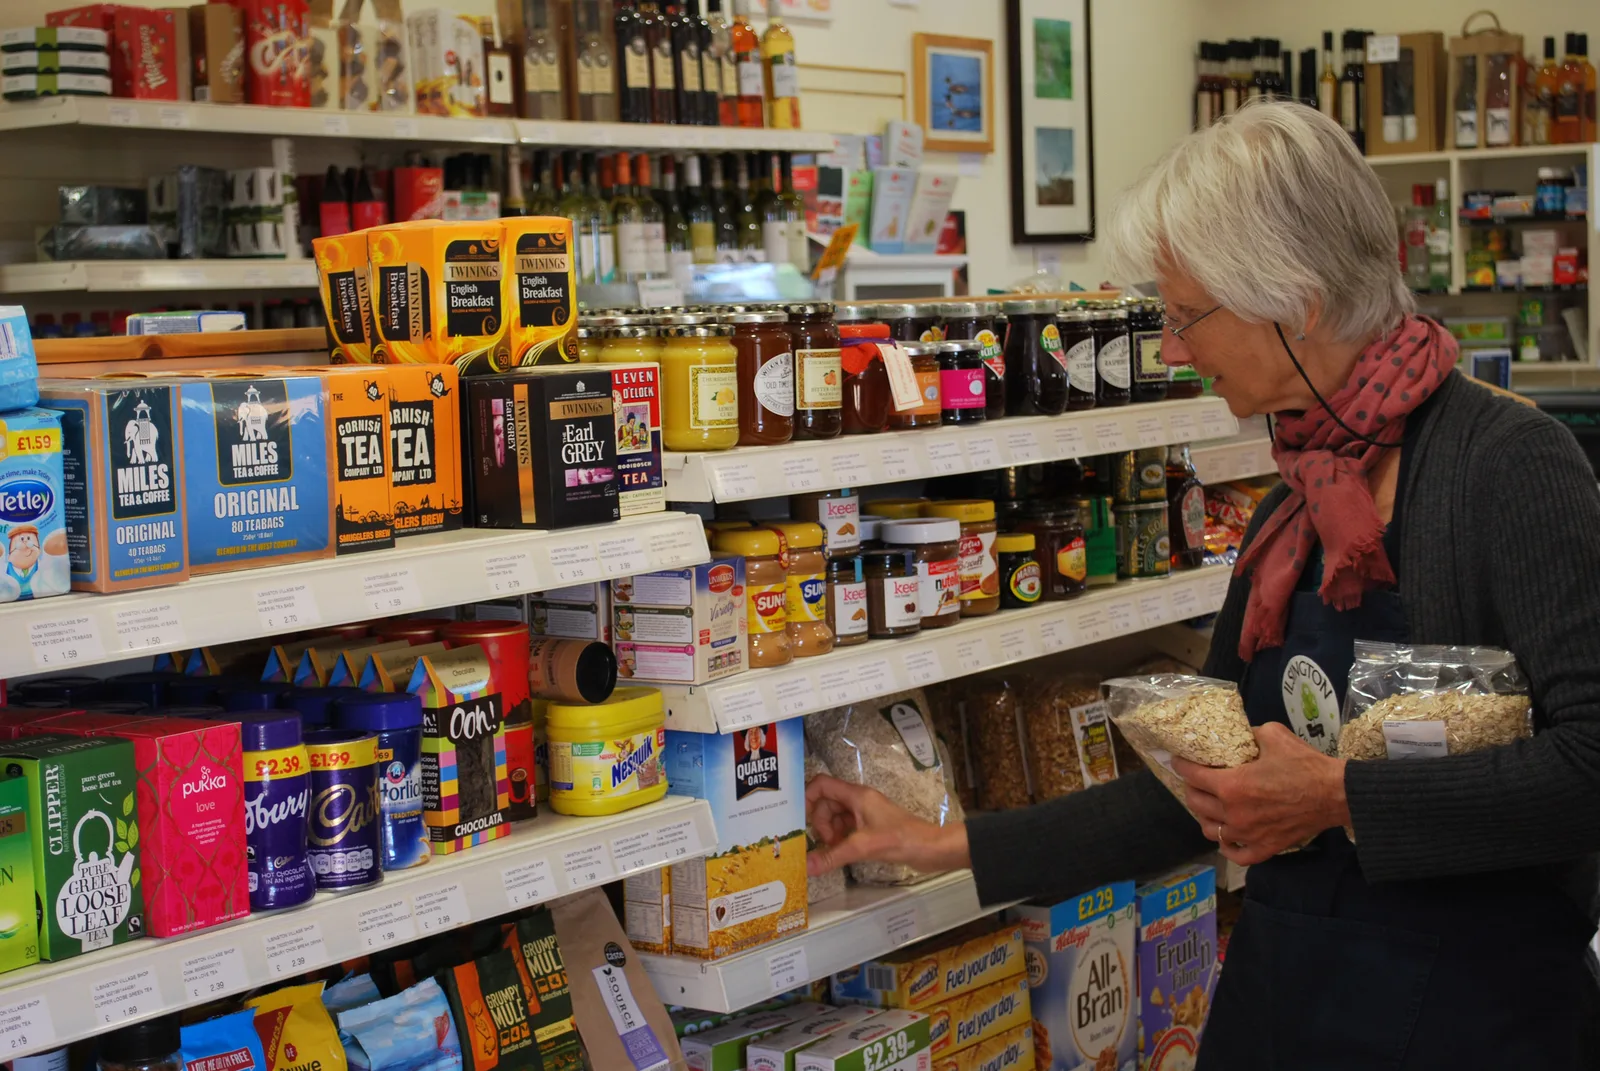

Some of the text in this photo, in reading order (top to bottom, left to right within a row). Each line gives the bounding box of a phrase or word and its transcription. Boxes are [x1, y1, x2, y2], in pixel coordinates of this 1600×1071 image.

[449, 264, 498, 279] TWININGS
[520, 258, 566, 270] TWININGS
[522, 276, 548, 287] English
[347, 277, 357, 311] English
[398, 272, 407, 308] English
[450, 284, 478, 297] English
[522, 286, 563, 299] Breakfast
[338, 278, 354, 334] Breakfast
[390, 272, 400, 331] Breakfast
[410, 272, 421, 337] TWININGS
[451, 296, 494, 308] Breakfast
[568, 344, 577, 355] 50
[500, 356, 508, 365] 50
[432, 378, 443, 393] 80
[615, 371, 655, 385] LEVEN
[332, 393, 343, 402] THE
[368, 386, 378, 396] 40
[623, 386, 655, 400] O'CLOCK
[561, 402, 604, 416] TWININGS
[338, 420, 381, 436] CORNISH
[506, 400, 516, 452] Earl GREY
[516, 398, 530, 465] TWININGS
[565, 422, 594, 444] Earl
[17, 435, 52, 451] £1.59
[342, 435, 382, 467] TEA
[232, 441, 279, 467] MILES
[561, 441, 604, 465] GREY
[233, 464, 279, 479] TEA & COFFEE
[344, 466, 383, 478] COMPANY LTD
[618, 461, 652, 470] ROOIBOSCH
[118, 464, 170, 493] MILES
[420, 468, 432, 480] LTD
[622, 472, 648, 485] TEA
[0, 491, 50, 516] Tetley
[119, 490, 170, 507] TEA & COFFEE
[214, 486, 299, 519] ORIGINAL
[232, 516, 285, 533] 80 TEABAGS
[422, 513, 444, 526] BREW
[116, 520, 176, 545] ORIGINAL
[338, 528, 391, 544] SMUGGLERS BREW
[128, 544, 166, 557] 40 TEABAGS
[284, 614, 298, 624] 2.70
[128, 636, 161, 649] £ 1.50
[44, 650, 78, 663] £ 1.59
[452, 667, 476, 678] Chocolata
[1284, 660, 1333, 700] ILSINGTON
[450, 701, 497, 740] Ooh!
[572, 744, 582, 757] NO
[255, 755, 300, 777] £2.39
[310, 752, 350, 768] £1.99
[611, 736, 654, 789] Nesquik
[736, 756, 778, 781] QUAKER
[82, 772, 116, 785] pure green
[82, 784, 98, 793] loose
[100, 780, 111, 789] leaf
[182, 768, 227, 799] pukka
[748, 772, 768, 786] OATS
[46, 764, 63, 856] CLIPPER
[196, 801, 216, 813] love
[455, 812, 503, 838] CHOCOLATA
[81, 862, 110, 879] PURE
[276, 866, 306, 878] CHOCOLATE
[285, 873, 306, 883] INSTANT
[68, 870, 120, 897] GREEN
[61, 884, 128, 919] LOOSE
[1078, 887, 1114, 921] £2.29
[1166, 882, 1197, 912] £2.19
[70, 904, 124, 936] LEAF
[438, 915, 451, 925] 2.99
[86, 930, 109, 943] TEA
[1013, 930, 1021, 941] 10
[1145, 916, 1178, 941] Kellogg's
[368, 932, 395, 946] £ 1.99
[1056, 926, 1092, 951] Kellogg's
[26, 946, 36, 957] 20
[224, 948, 235, 956] SHOP
[606, 951, 625, 960] taste
[1156, 929, 1199, 977] Fruit
[276, 956, 305, 972] £ 2.39
[137, 970, 149, 979] SHOP
[910, 965, 939, 996] Weetabix
[946, 966, 967, 992] Fuel
[968, 954, 989, 984] your
[1087, 952, 1118, 995] All-
[1172, 966, 1200, 994] Fibre
[194, 982, 225, 997] £ 2.39
[1020, 979, 1028, 991] 10
[486, 984, 520, 1010] GRUMPY
[608, 976, 636, 1029] SOURCE
[8, 1000, 40, 1014] VILLAGE SHOP
[105, 1006, 138, 1023] £ 1.89
[491, 998, 527, 1030] MULE
[1077, 985, 1123, 1030] Bran
[5, 1024, 21, 1033] GREEN
[957, 1014, 976, 1044] Fuel
[976, 1004, 997, 1035] your
[1024, 1028, 1032, 1039] 10
[11, 1036, 28, 1048] 2.19
[232, 1050, 250, 1066] FREE
[863, 1030, 909, 1071] £2.39
